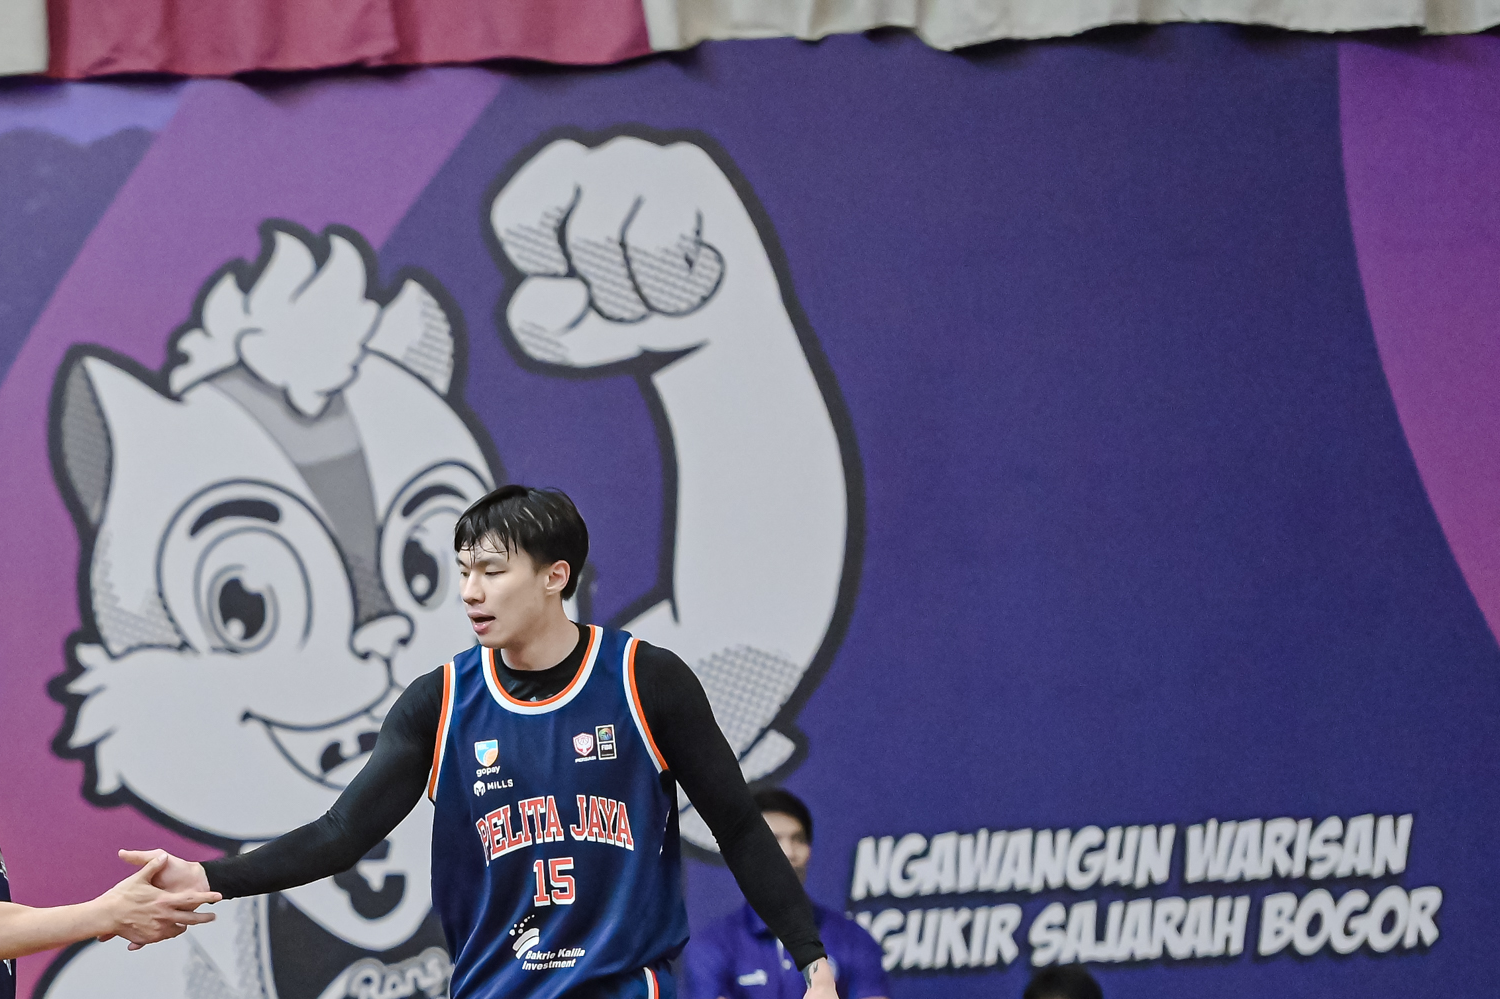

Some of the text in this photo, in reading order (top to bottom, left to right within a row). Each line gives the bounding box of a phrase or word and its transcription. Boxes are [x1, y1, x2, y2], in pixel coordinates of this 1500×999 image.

[476, 765, 501, 778] gopay
[487, 778, 514, 791] MILLS
[475, 794, 635, 867] PELITA JAYA
[851, 813, 1414, 900] NGAWANGUN WARISAN
[533, 857, 576, 907] 15
[1028, 896, 1250, 967] SAJARAH
[1258, 885, 1444, 956] BOGOR
[522, 958, 576, 970] Investment
[525, 950, 556, 960] Bakrie
